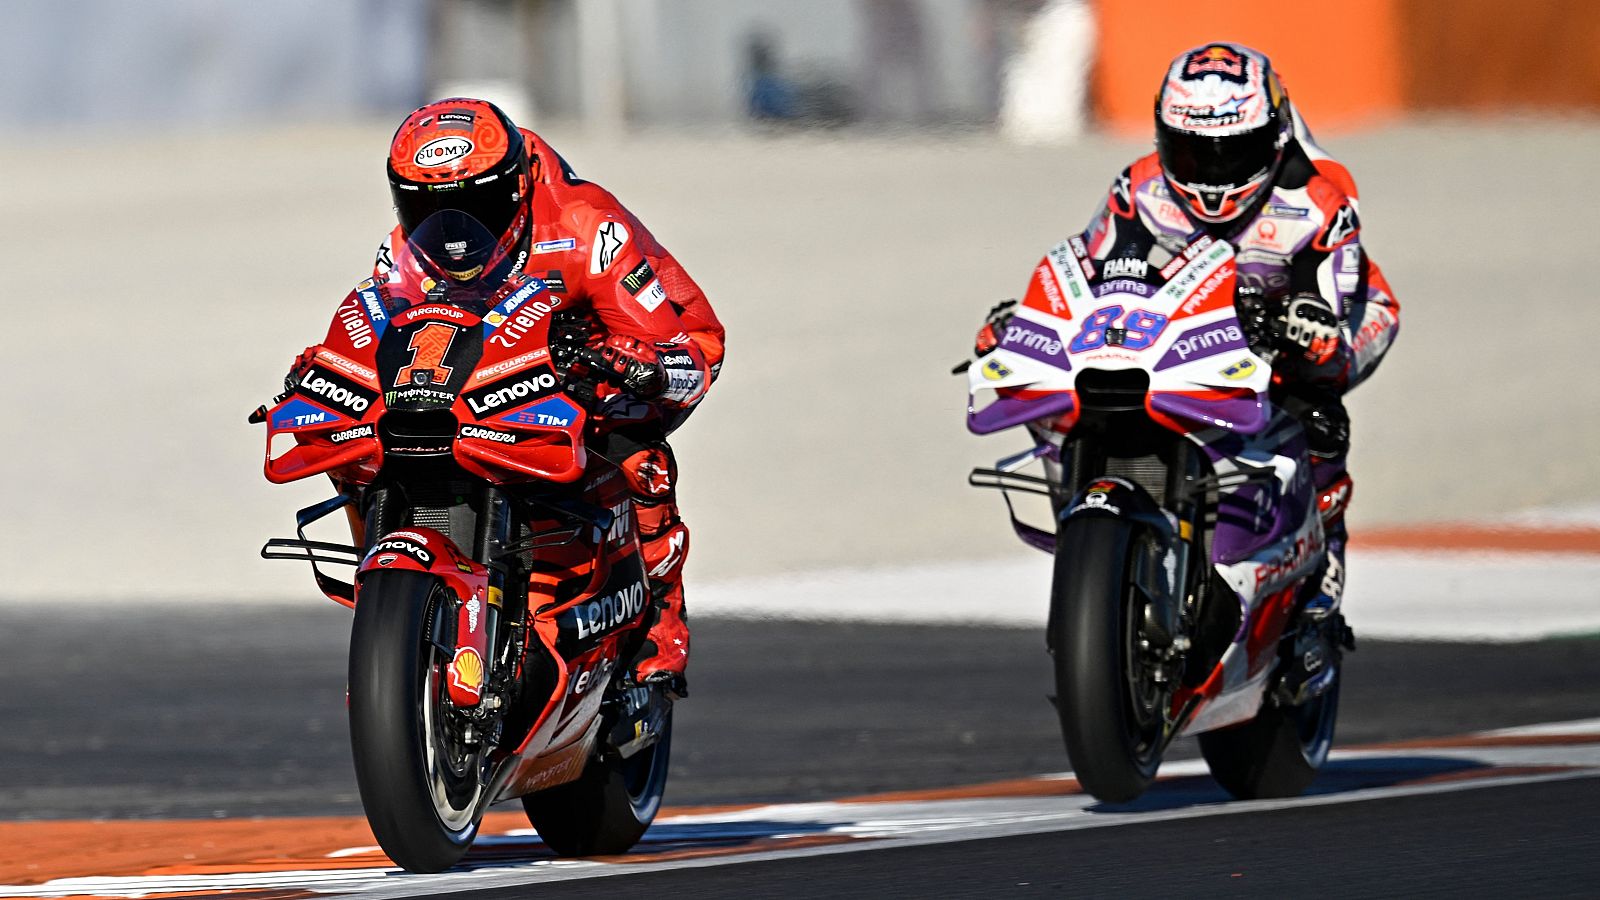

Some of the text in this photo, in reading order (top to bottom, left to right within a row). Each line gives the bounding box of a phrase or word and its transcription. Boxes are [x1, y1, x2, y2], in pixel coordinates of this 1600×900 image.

[419, 145, 467, 160] SUOMY
[504, 280, 541, 313] ADVANCE
[1099, 280, 1147, 296] prima
[1181, 266, 1234, 314] PRAMAC
[406, 307, 464, 320] VARGROUP
[1002, 326, 1062, 356] prima
[1067, 304, 1170, 354] 89
[1171, 325, 1242, 360] prima
[319, 350, 376, 380] FRECCIAROSSA
[393, 321, 459, 388] 1
[476, 349, 548, 379] FRECCIAROSSA
[300, 369, 369, 412] Lenovo
[467, 373, 555, 414] Lenovo
[295, 412, 325, 426] TIM
[330, 425, 373, 443] CARRERA
[537, 413, 568, 427] TIM
[461, 426, 516, 444] CARRERA
[574, 581, 644, 640] Lenovo
